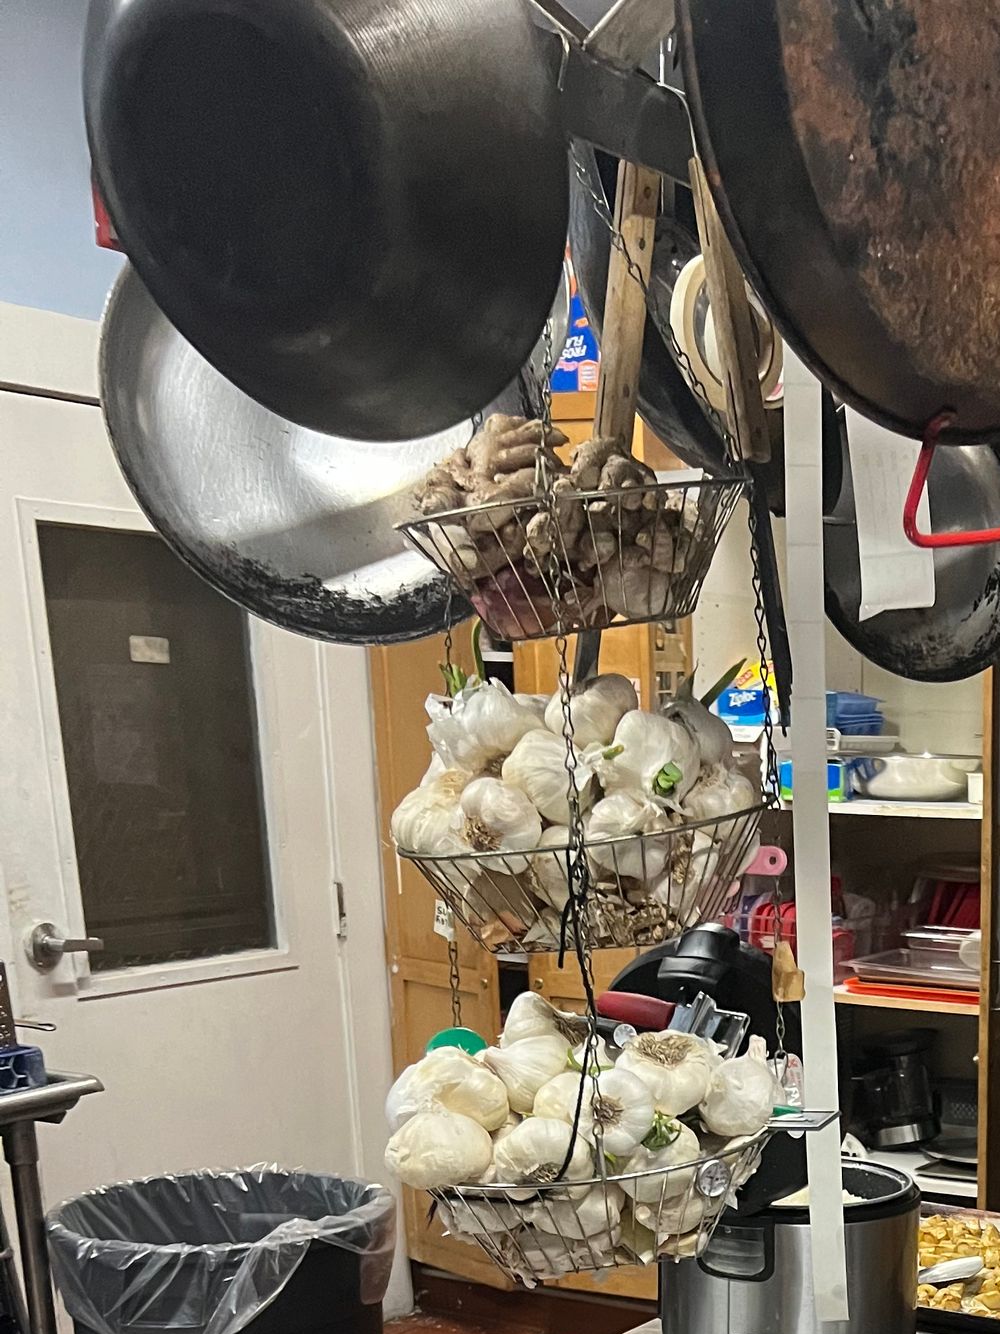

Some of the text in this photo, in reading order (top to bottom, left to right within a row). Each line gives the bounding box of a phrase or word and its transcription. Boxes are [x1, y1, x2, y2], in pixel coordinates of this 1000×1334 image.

[565, 335, 584, 348] FLA
[562, 345, 587, 358] FROS
[728, 690, 757, 707] Ziploc
